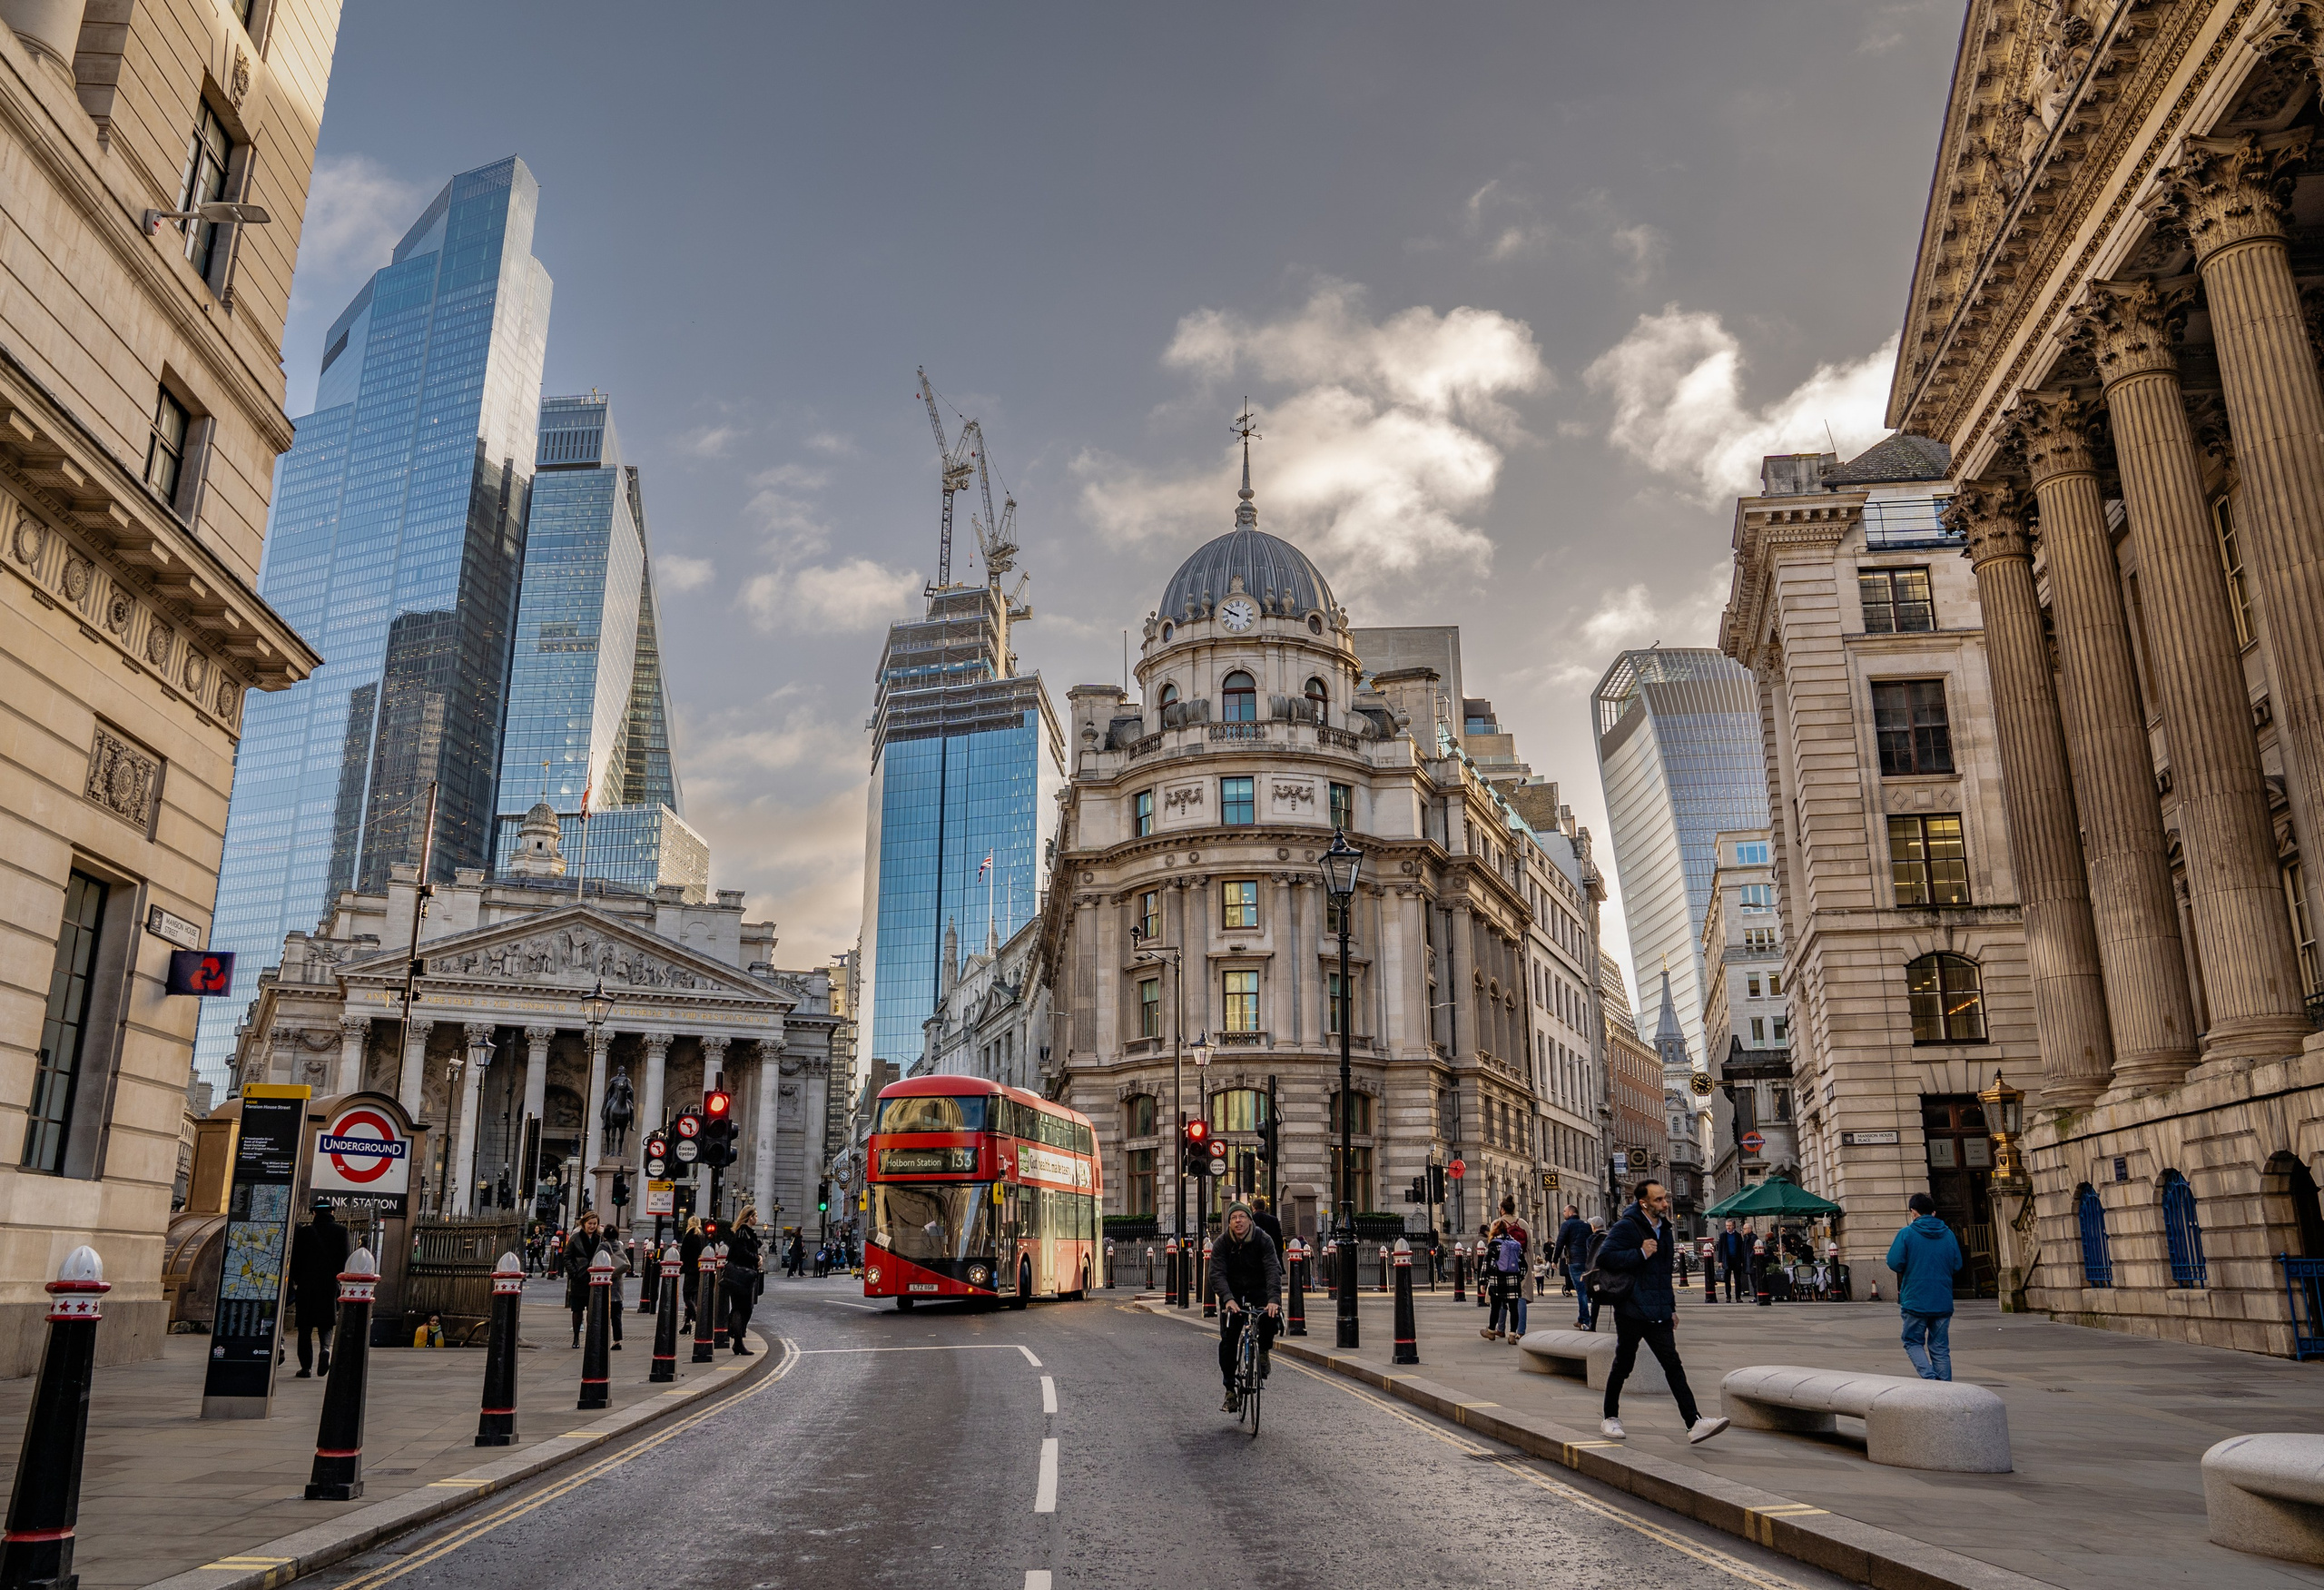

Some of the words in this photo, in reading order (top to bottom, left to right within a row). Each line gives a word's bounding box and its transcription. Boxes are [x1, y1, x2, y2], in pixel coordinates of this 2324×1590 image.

[164, 926, 178, 937] STREET
[165, 917, 184, 931] MANSION
[184, 925, 197, 937] HOUSE
[323, 1138, 402, 1155] UNDERGROUND
[886, 1158, 915, 1167] Holborn
[917, 1158, 941, 1167] Station
[950, 1152, 972, 1168] 133
[1544, 1175, 1556, 1185] 82
[318, 1196, 348, 1208] NK
[353, 1197, 398, 1210] STATON
